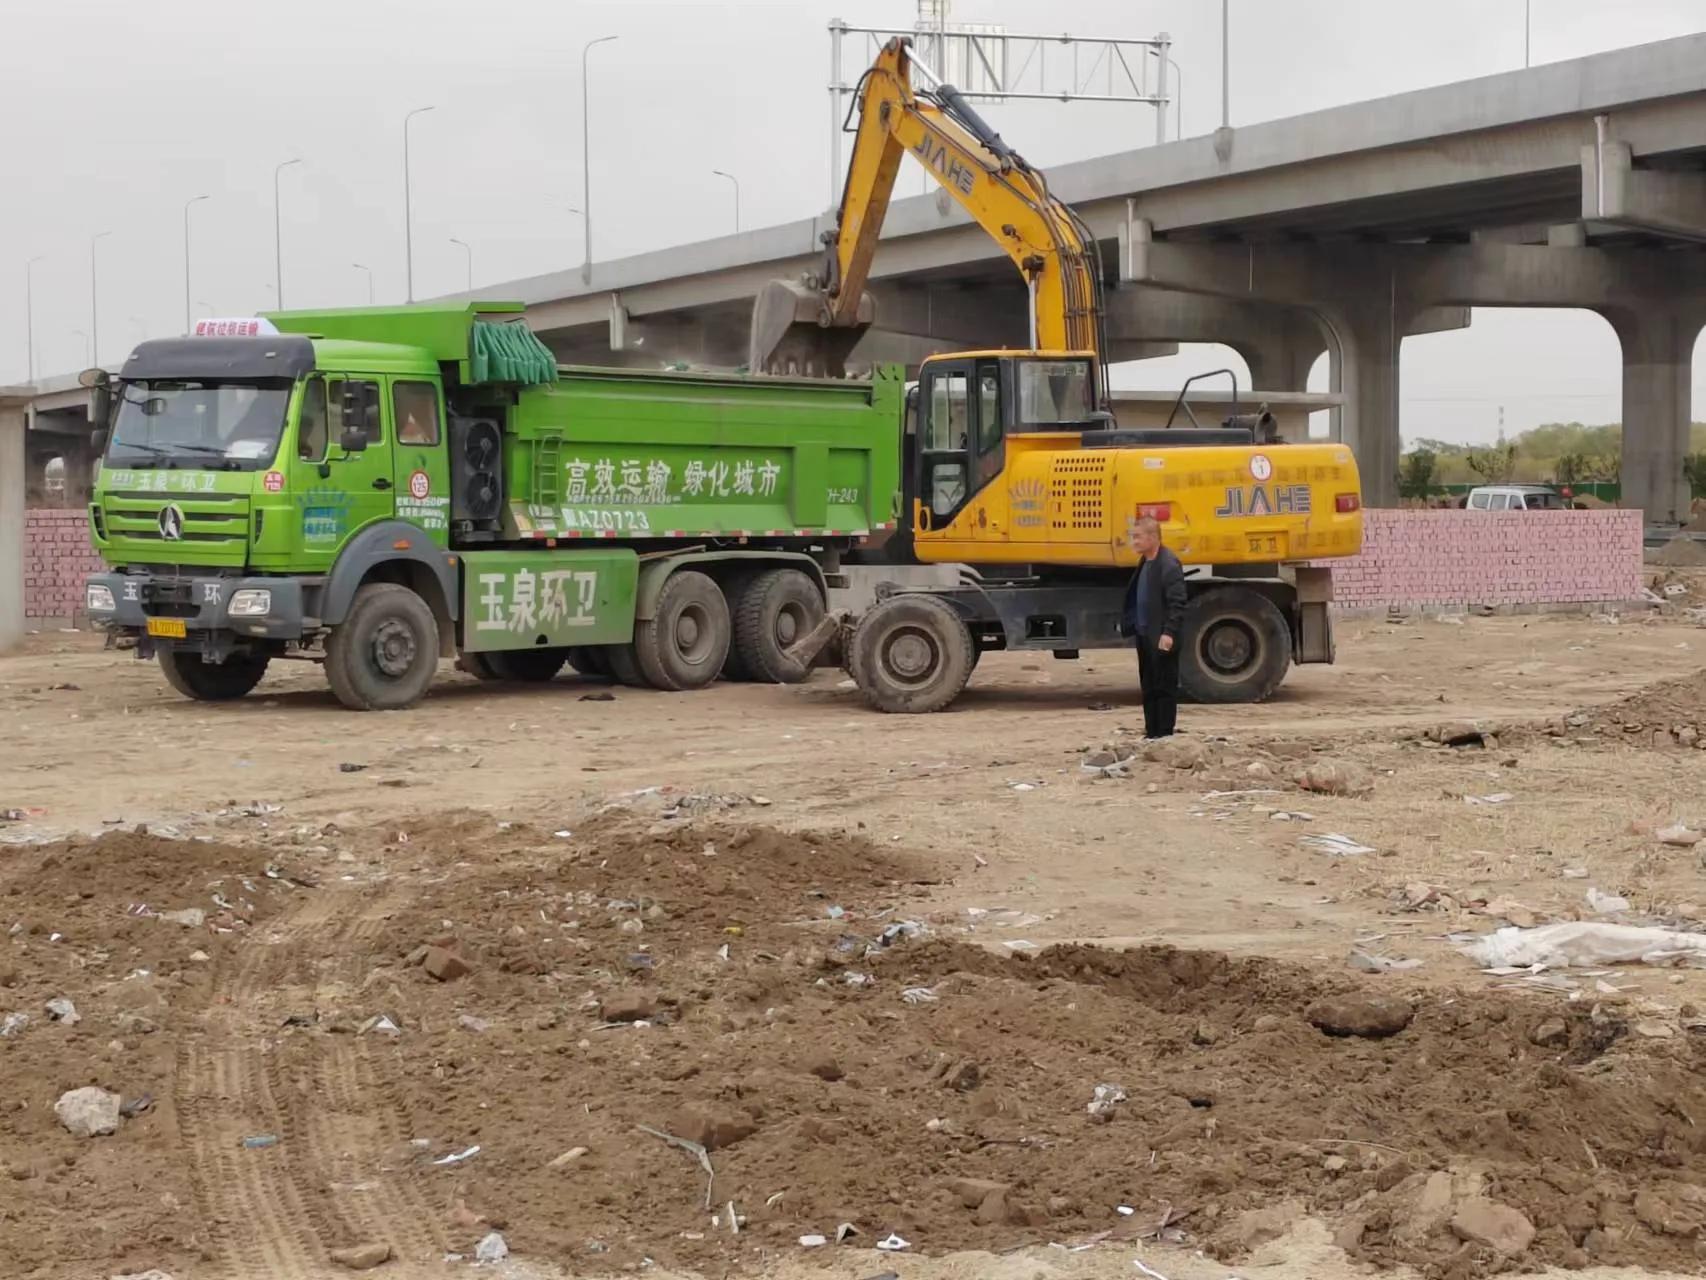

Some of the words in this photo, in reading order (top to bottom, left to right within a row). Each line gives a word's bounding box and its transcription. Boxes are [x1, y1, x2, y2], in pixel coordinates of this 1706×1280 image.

[913, 134, 977, 196] JIAHE
[565, 458, 671, 496] 高效运输
[681, 459, 781, 497] 绿化城市
[1215, 483, 1313, 518] JIAHE
[476, 567, 598, 633] 玉泉环卫
